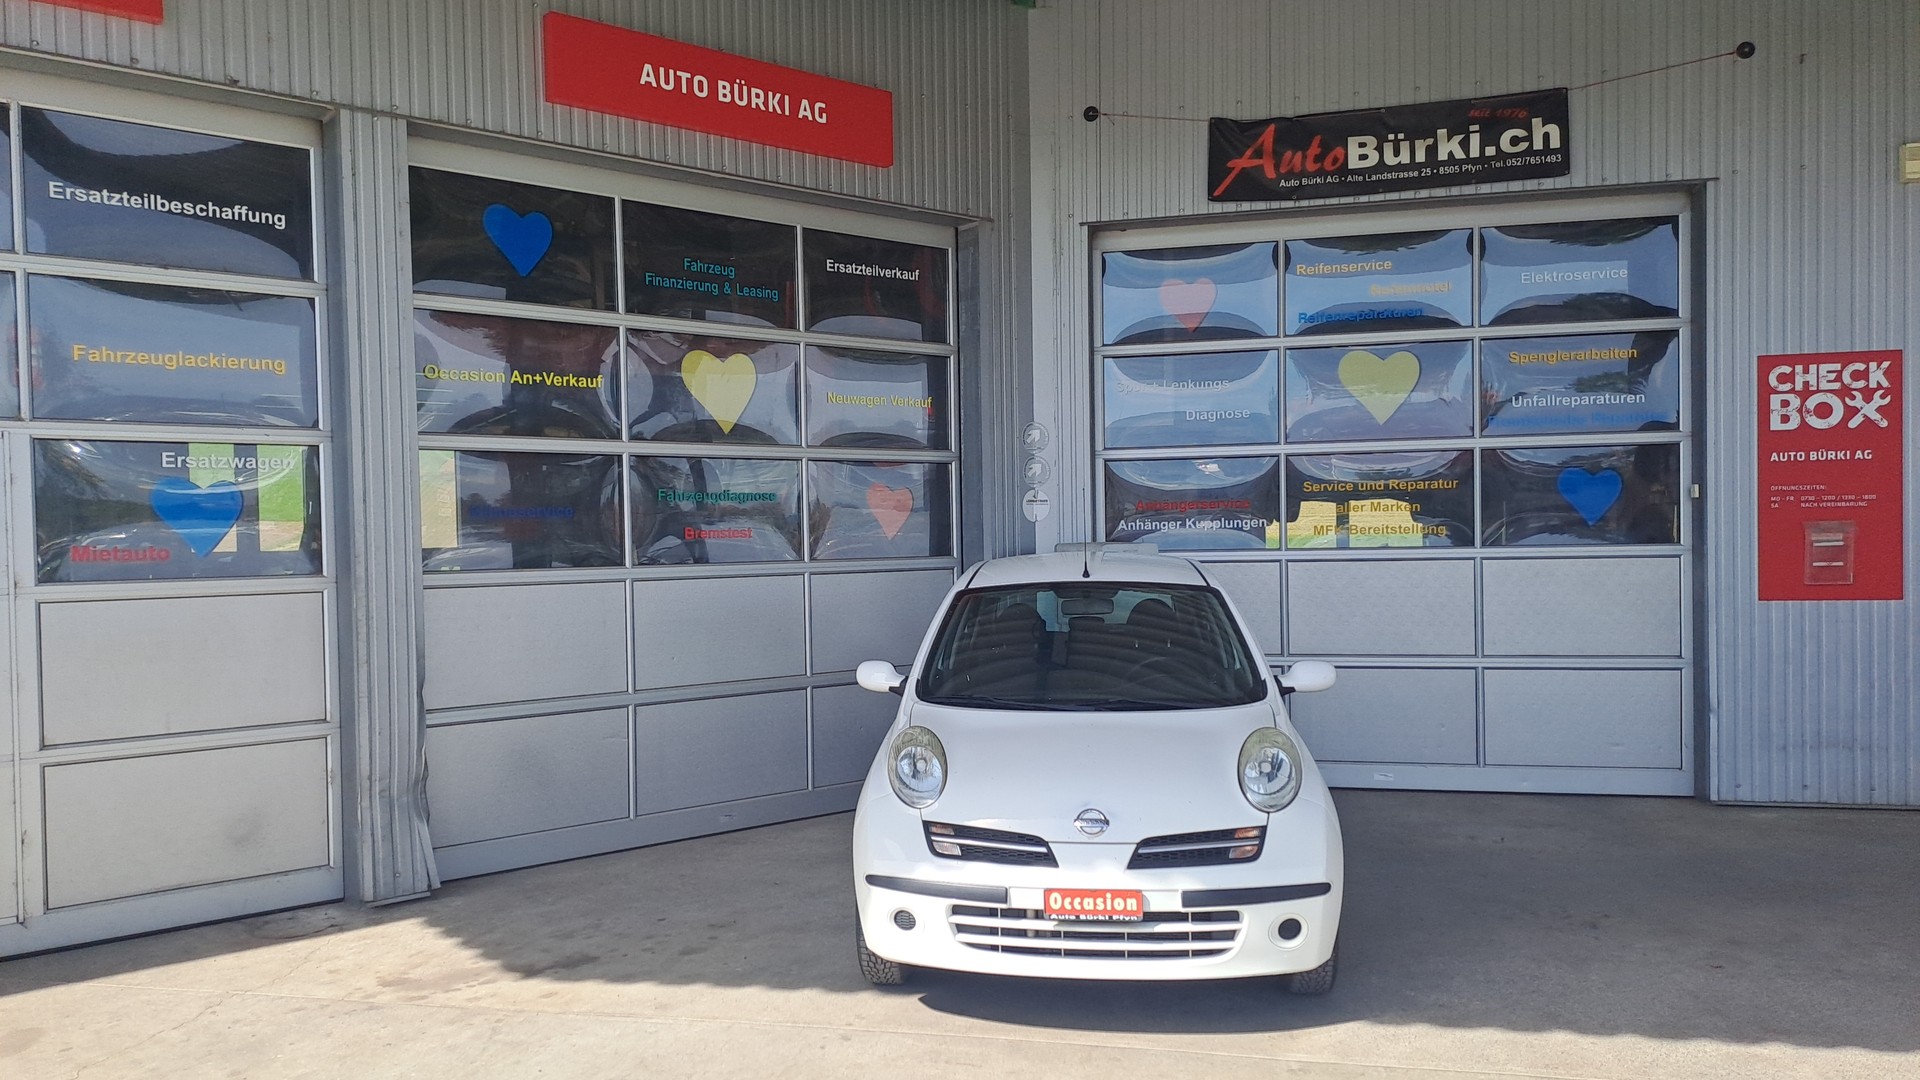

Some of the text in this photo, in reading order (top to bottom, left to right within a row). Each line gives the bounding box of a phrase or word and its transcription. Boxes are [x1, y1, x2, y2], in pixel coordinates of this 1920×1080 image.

[639, 63, 828, 124] AUTO BÜRKI AG
[1279, 179, 1300, 188] Auto
[1301, 175, 1325, 186] Bürki
[1326, 175, 1340, 183] AG
[1346, 173, 1364, 183] Alte
[1365, 169, 1419, 182] Landstrasse
[1420, 167, 1432, 177] 25
[1438, 165, 1460, 175] 8505
[1461, 163, 1483, 174] Pfyn
[48, 181, 287, 230] Ersatzteilbeschaffung
[683, 257, 736, 279] Fahrzeug
[825, 259, 921, 281] Ersatzteilverkauf
[1296, 259, 1393, 276] Reifenservice
[1521, 267, 1629, 284] Elektroservice
[644, 272, 780, 302] Finanzierung & Leasing
[72, 344, 286, 375] Fahrzeuglackierung
[1508, 347, 1638, 365] Spenglerarbeiten
[423, 364, 604, 388] Occasion An+Verkauf
[1768, 360, 1892, 392] CHECK
[1163, 379, 1231, 392] Lenkungs
[826, 391, 933, 409] Neuwagen Verkauf
[1511, 392, 1646, 409] Unfallreparaturen
[1185, 408, 1251, 423] Diagnose
[161, 451, 297, 474] Ersatzwagen
[1770, 449, 1873, 462] AUTO BÜRKI AG
[1302, 478, 1459, 493] Service und Reparatur
[657, 488, 778, 504] Fahrzeugdiagnose
[1336, 500, 1421, 514] aller Marken
[683, 526, 754, 540] Bremstest
[1117, 517, 1268, 533] Anhänger Kupplungen
[1349, 523, 1447, 537] Bereitstellung
[70, 545, 171, 563] Mietauto
[1049, 891, 1138, 912] Occasion
[1050, 913, 1076, 921] Auto
